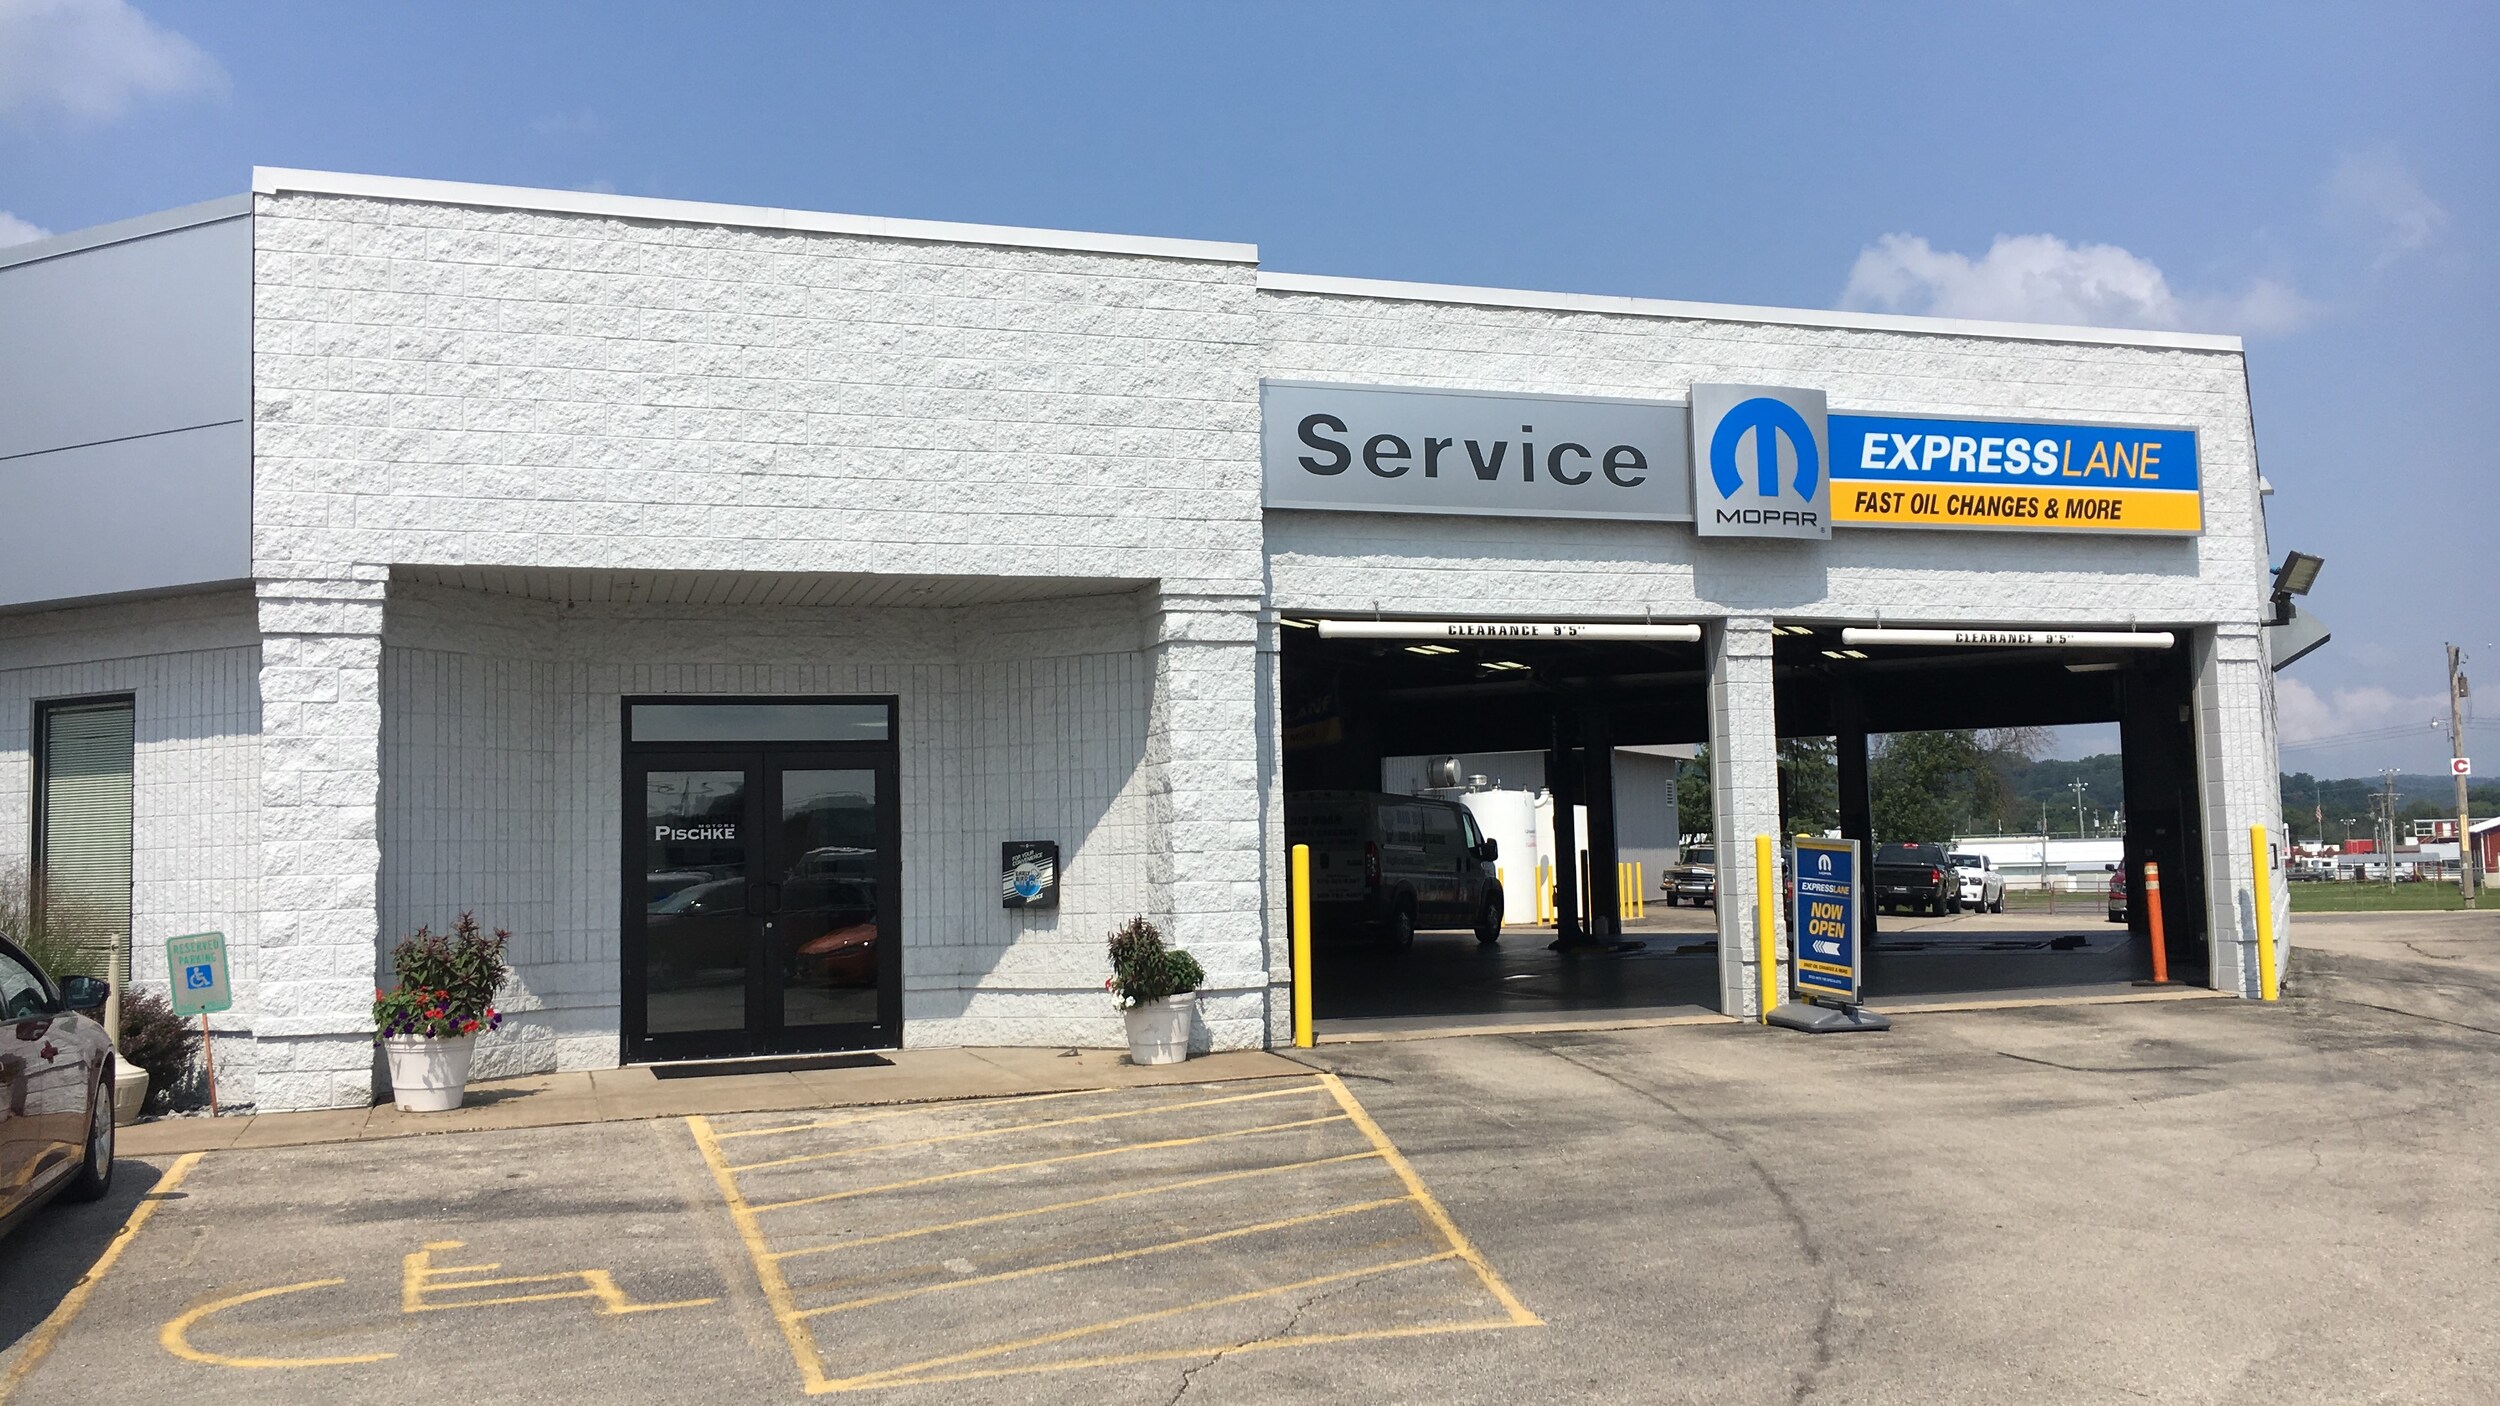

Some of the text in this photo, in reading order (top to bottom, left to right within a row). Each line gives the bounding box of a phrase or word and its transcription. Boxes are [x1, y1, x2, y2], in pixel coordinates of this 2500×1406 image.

[1297, 412, 1649, 488] Service
[1860, 432, 2162, 480] EXPRESSLANE
[1854, 491, 2123, 521] FAST OIL CHANGES & MORE
[1715, 508, 1819, 528] MOPAR
[1447, 624, 1540, 637] CLEARANCE
[1955, 632, 2035, 644] CLEARANCE
[2453, 759, 2468, 773] C
[1811, 902, 1844, 920] NOW
[1808, 919, 1846, 939] OPEN
[173, 939, 219, 955] RESERVED
[178, 952, 217, 965] PARKING
